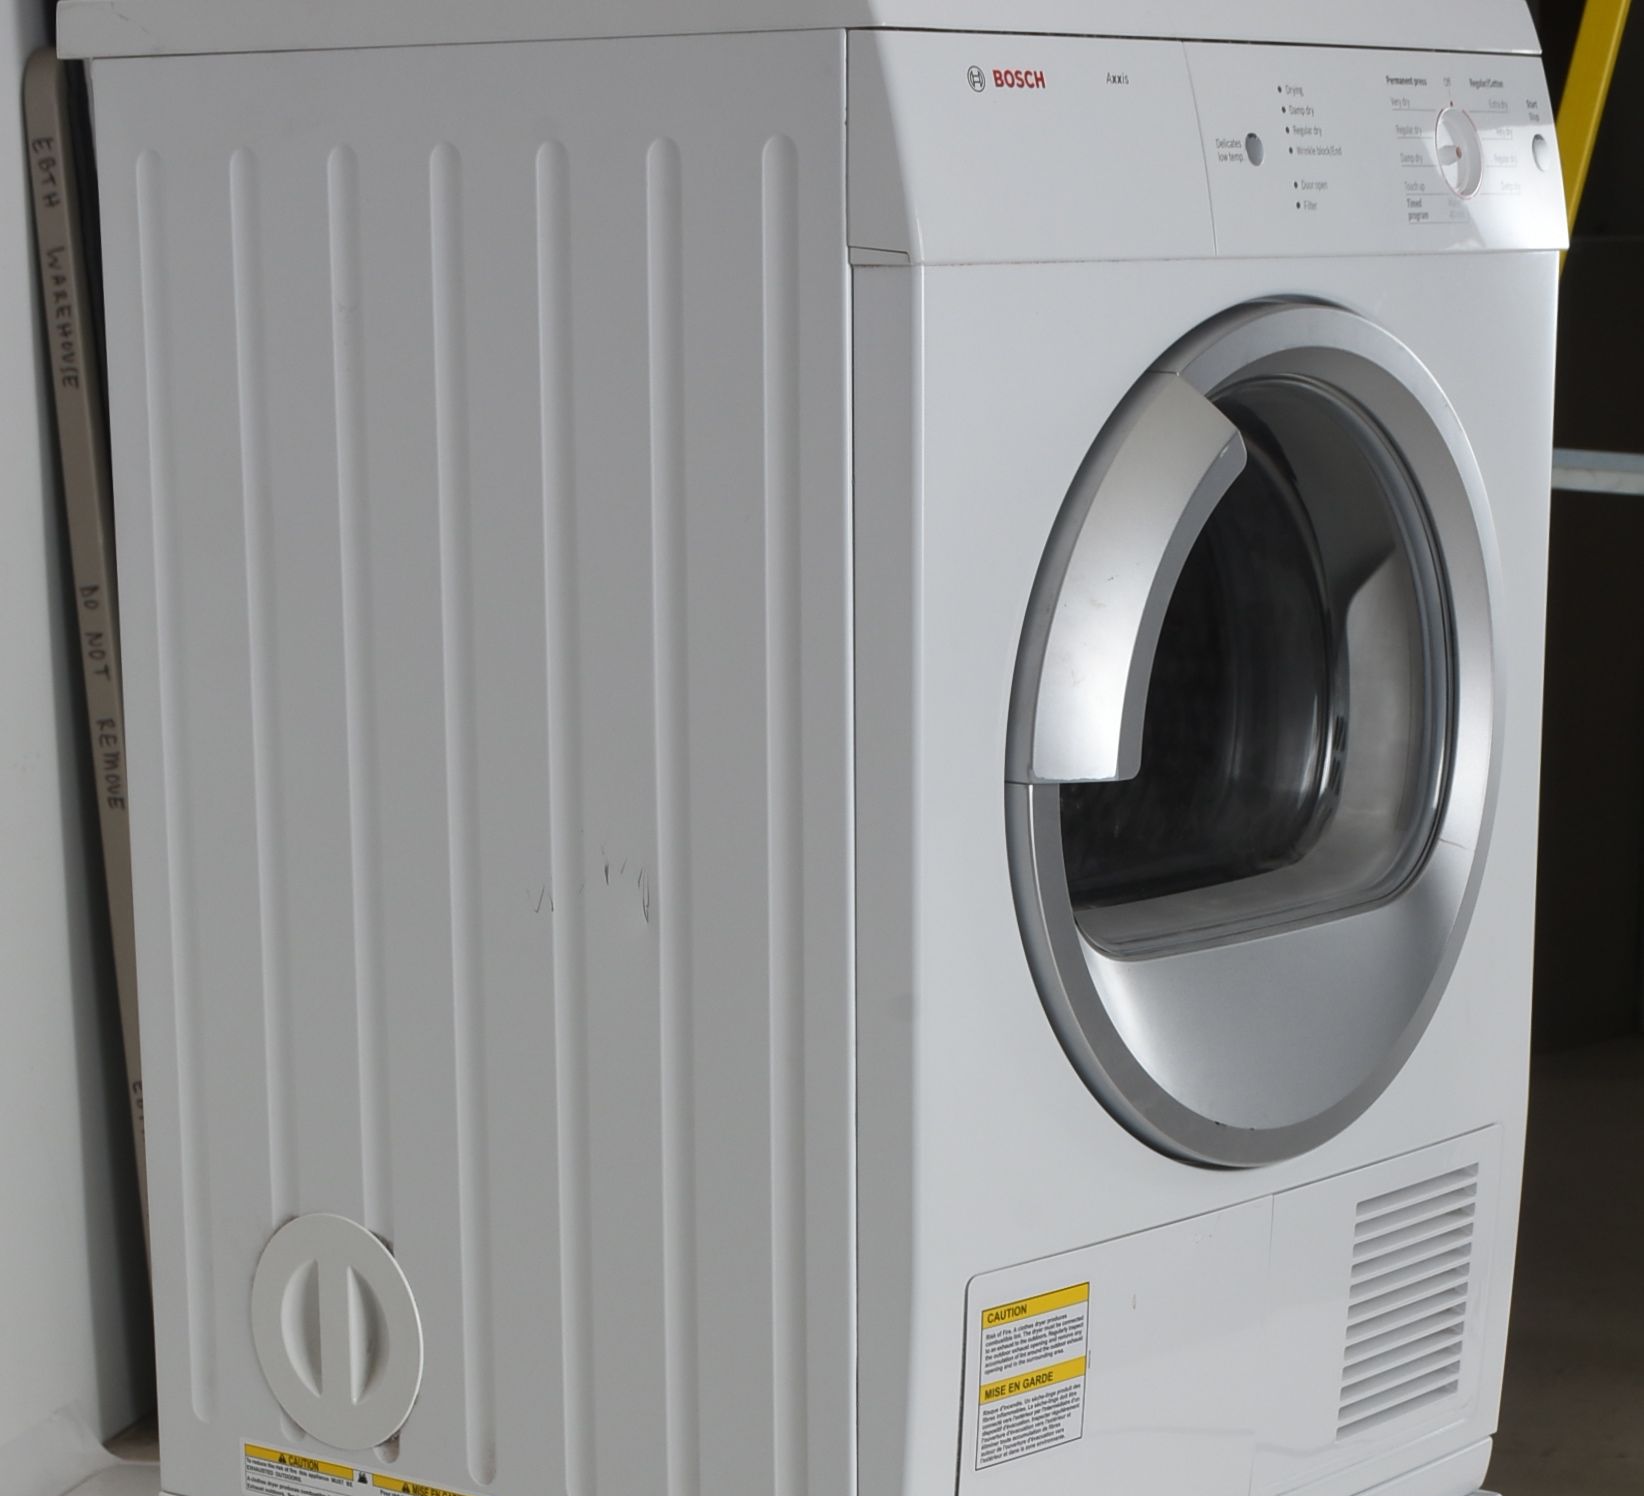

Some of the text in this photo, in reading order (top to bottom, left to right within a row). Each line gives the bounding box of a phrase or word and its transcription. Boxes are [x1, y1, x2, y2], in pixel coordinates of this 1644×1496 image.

[992, 69, 1046, 89] BOSCH
[1106, 72, 1130, 86] Axxis
[33, 136, 80, 391] EBTH WAREHOUSE
[84, 631, 111, 682] NOT
[987, 1304, 1027, 1323] CAUTION
[985, 1371, 1053, 1399] MISE EN GARDE
[288, 1455, 319, 1472] CAUTION
